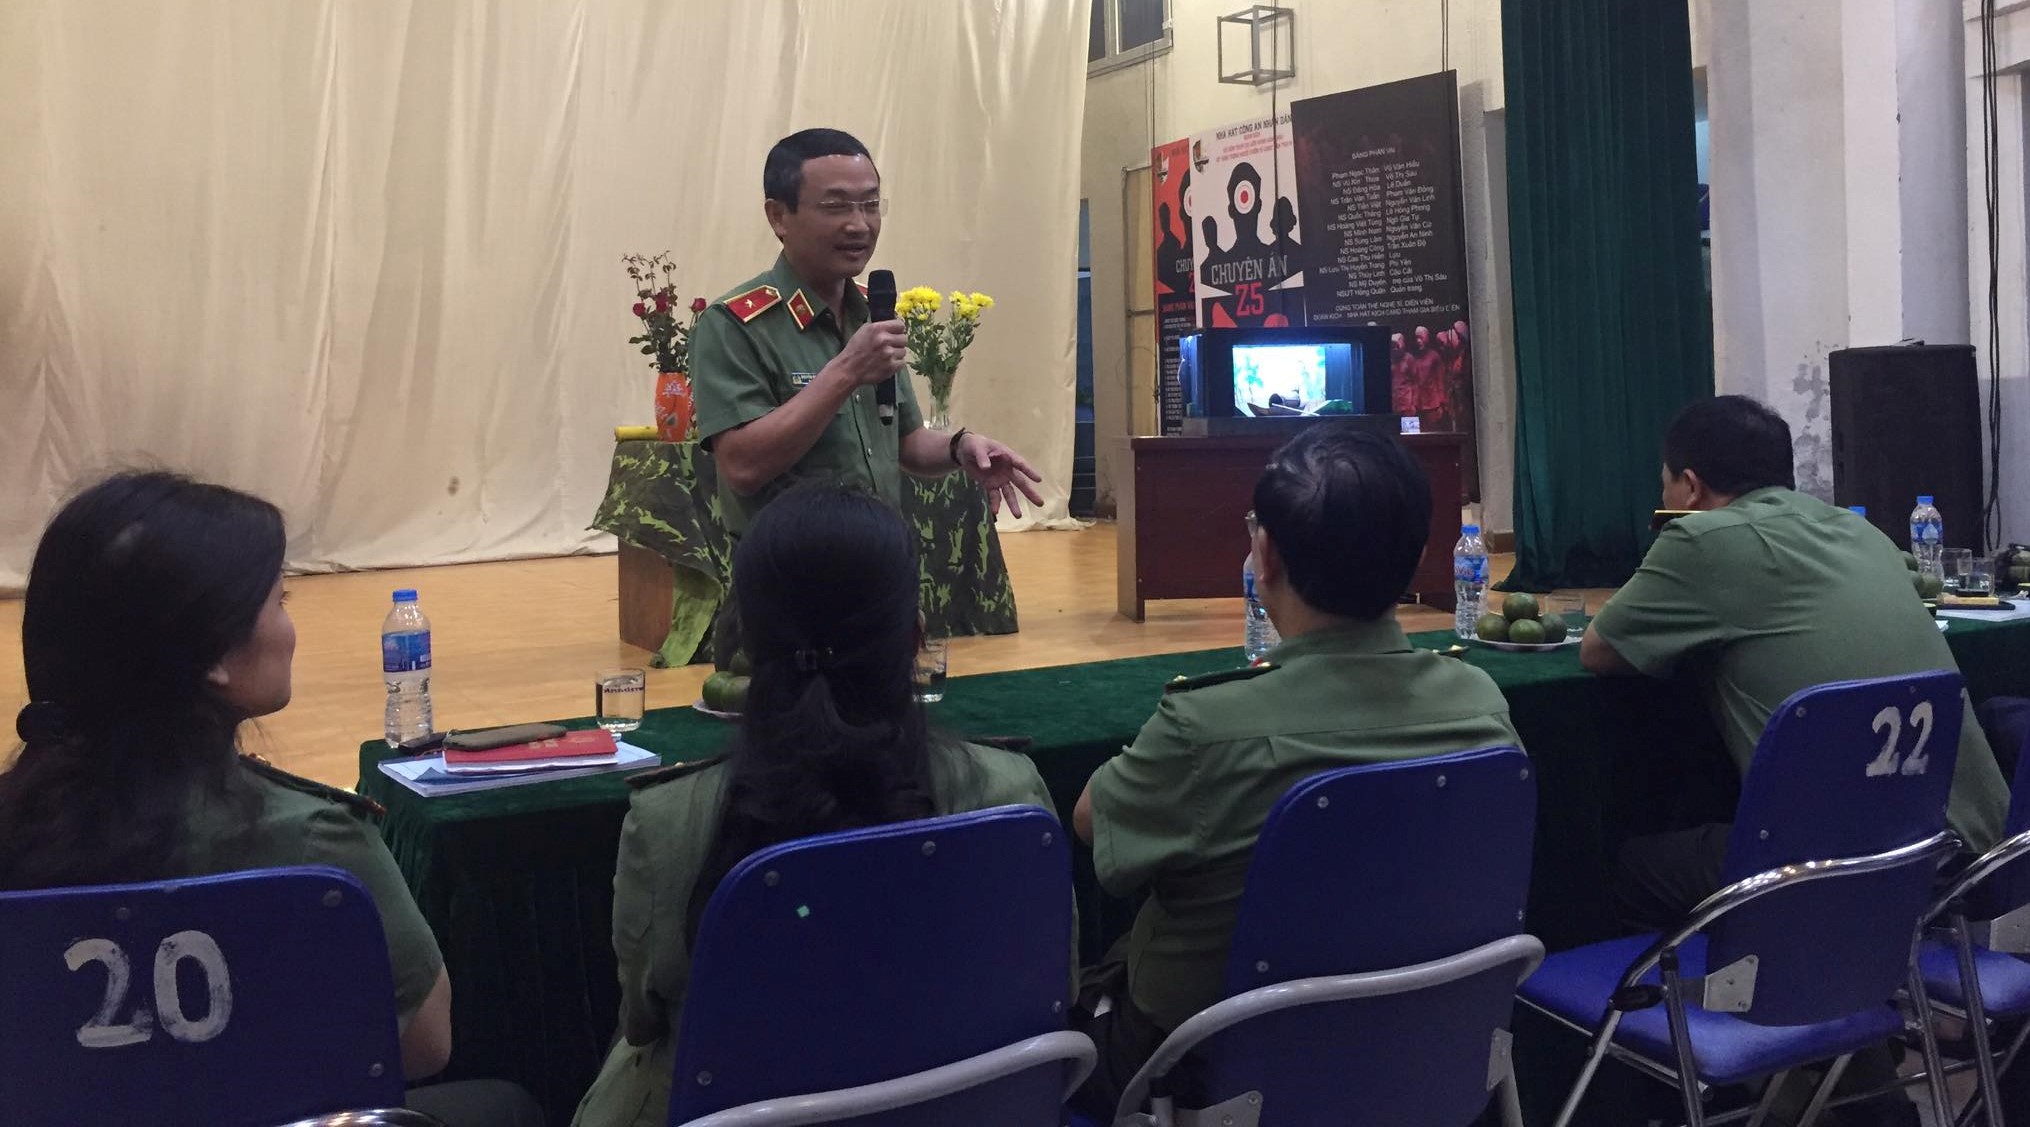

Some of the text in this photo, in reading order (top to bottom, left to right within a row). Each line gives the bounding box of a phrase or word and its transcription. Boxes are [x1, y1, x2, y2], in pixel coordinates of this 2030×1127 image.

[1254, 121, 1262, 130] AN
[1268, 252, 1288, 278] ÁN
[1235, 282, 1264, 316] Z5
[1866, 702, 1933, 777] 22
[64, 930, 233, 1047] 20
